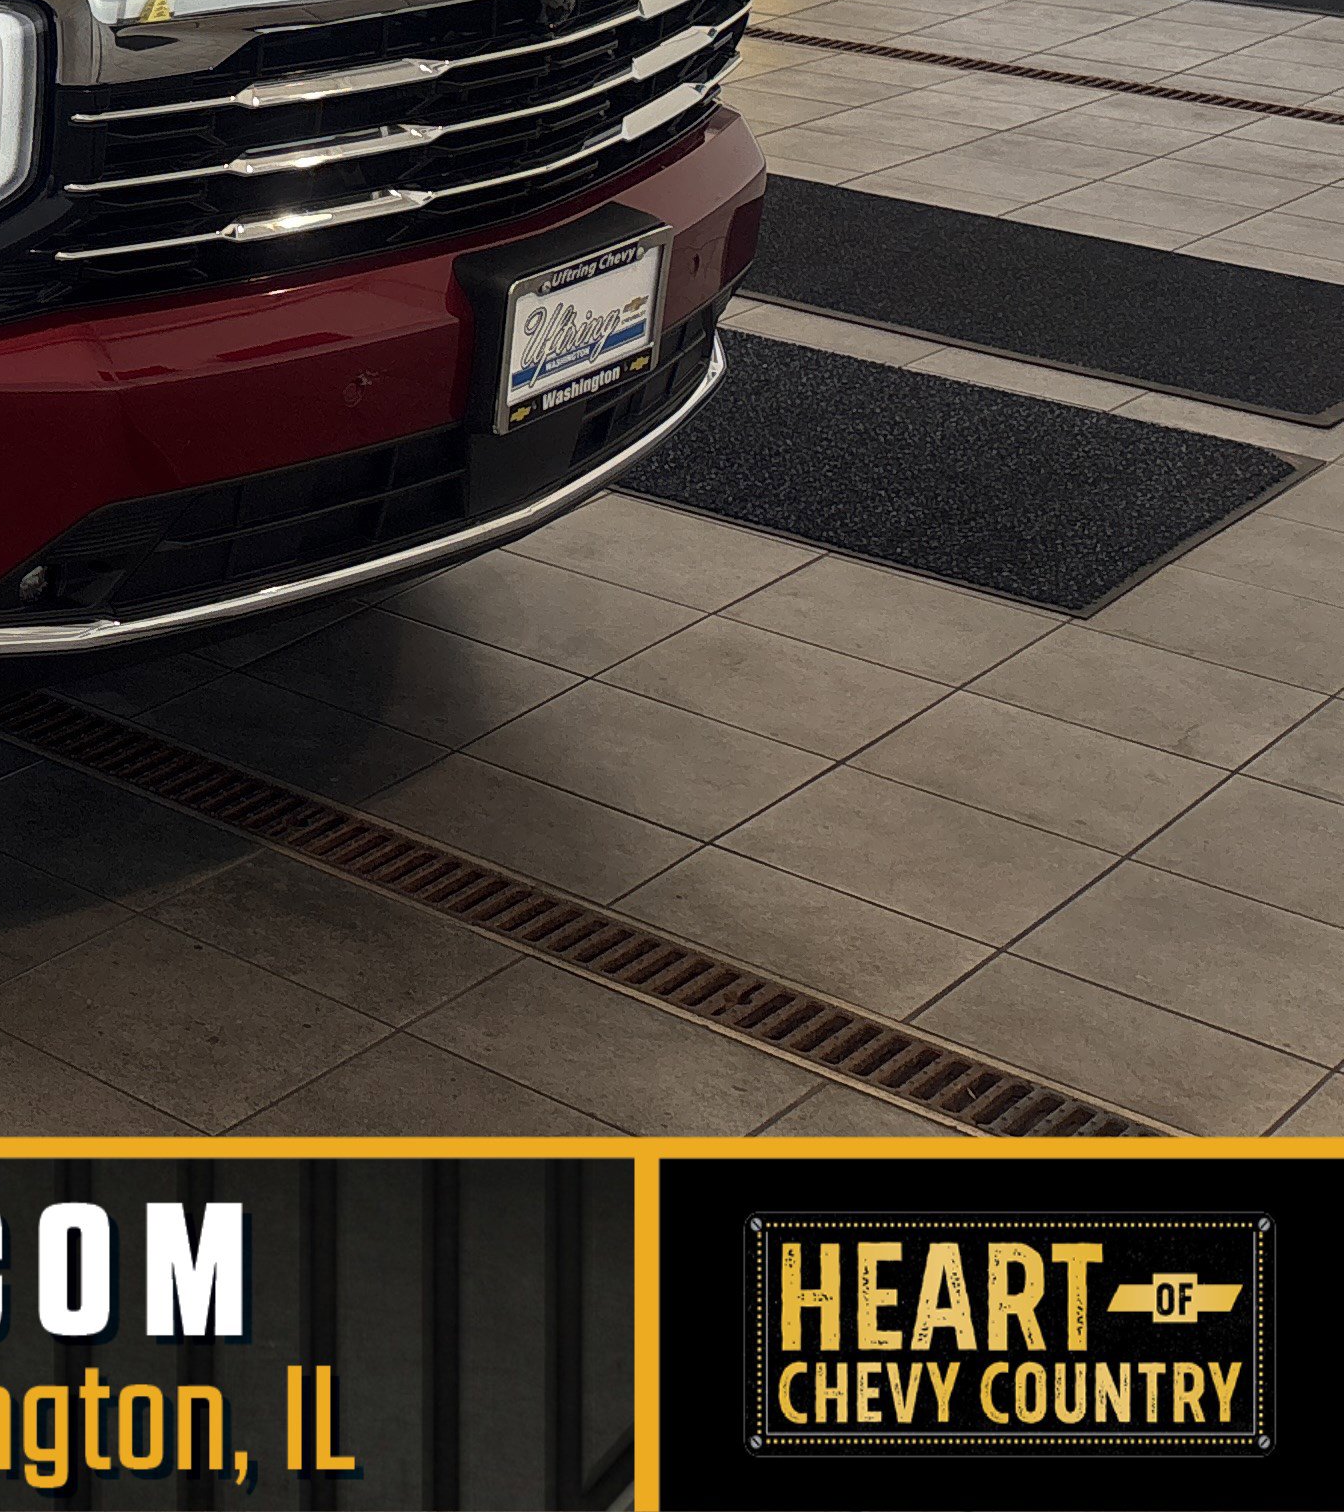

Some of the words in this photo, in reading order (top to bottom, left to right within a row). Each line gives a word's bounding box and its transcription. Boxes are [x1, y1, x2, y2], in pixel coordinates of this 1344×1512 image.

[552, 262, 597, 288] Uftring
[598, 248, 636, 270] Chevy
[542, 365, 622, 411] Washington
